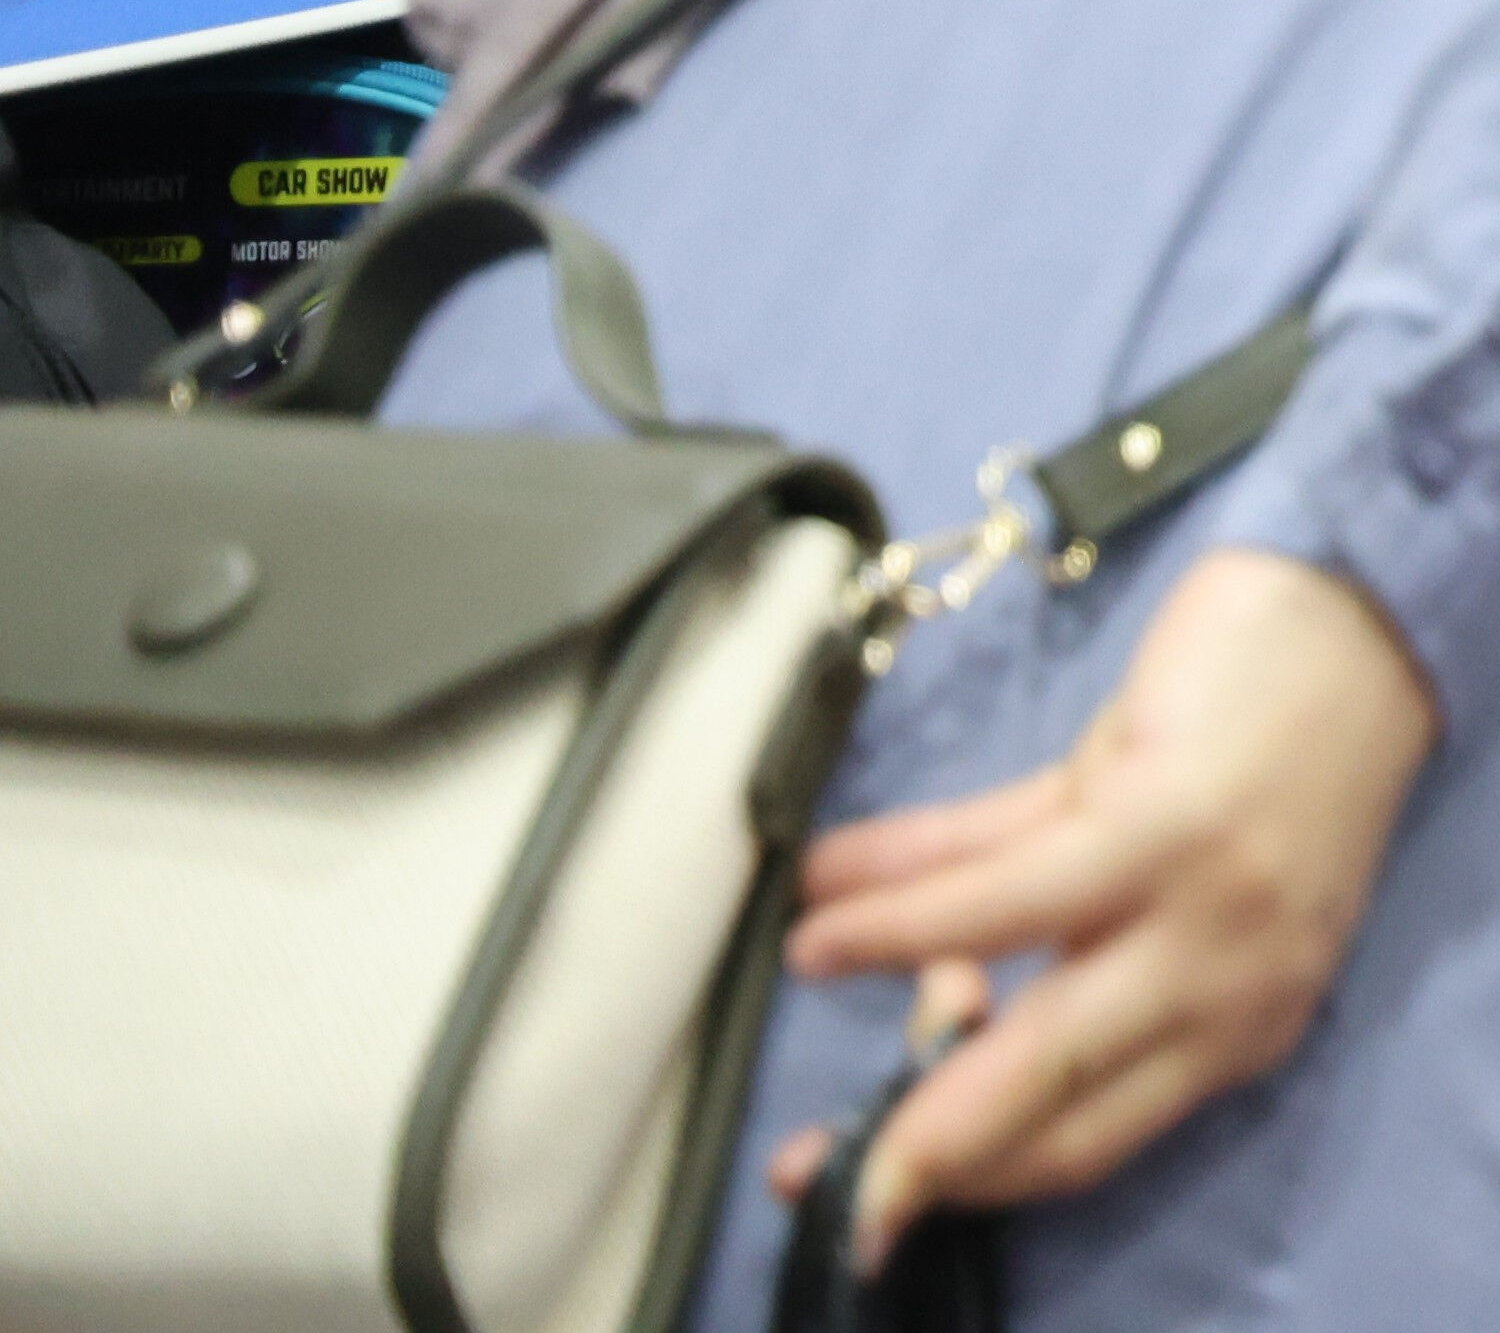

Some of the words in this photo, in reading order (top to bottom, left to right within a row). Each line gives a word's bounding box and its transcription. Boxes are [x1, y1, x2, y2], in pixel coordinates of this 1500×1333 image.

[258, 169, 308, 197] CAR
[316, 166, 390, 196] SHOW
[231, 240, 290, 263] MOTOR
